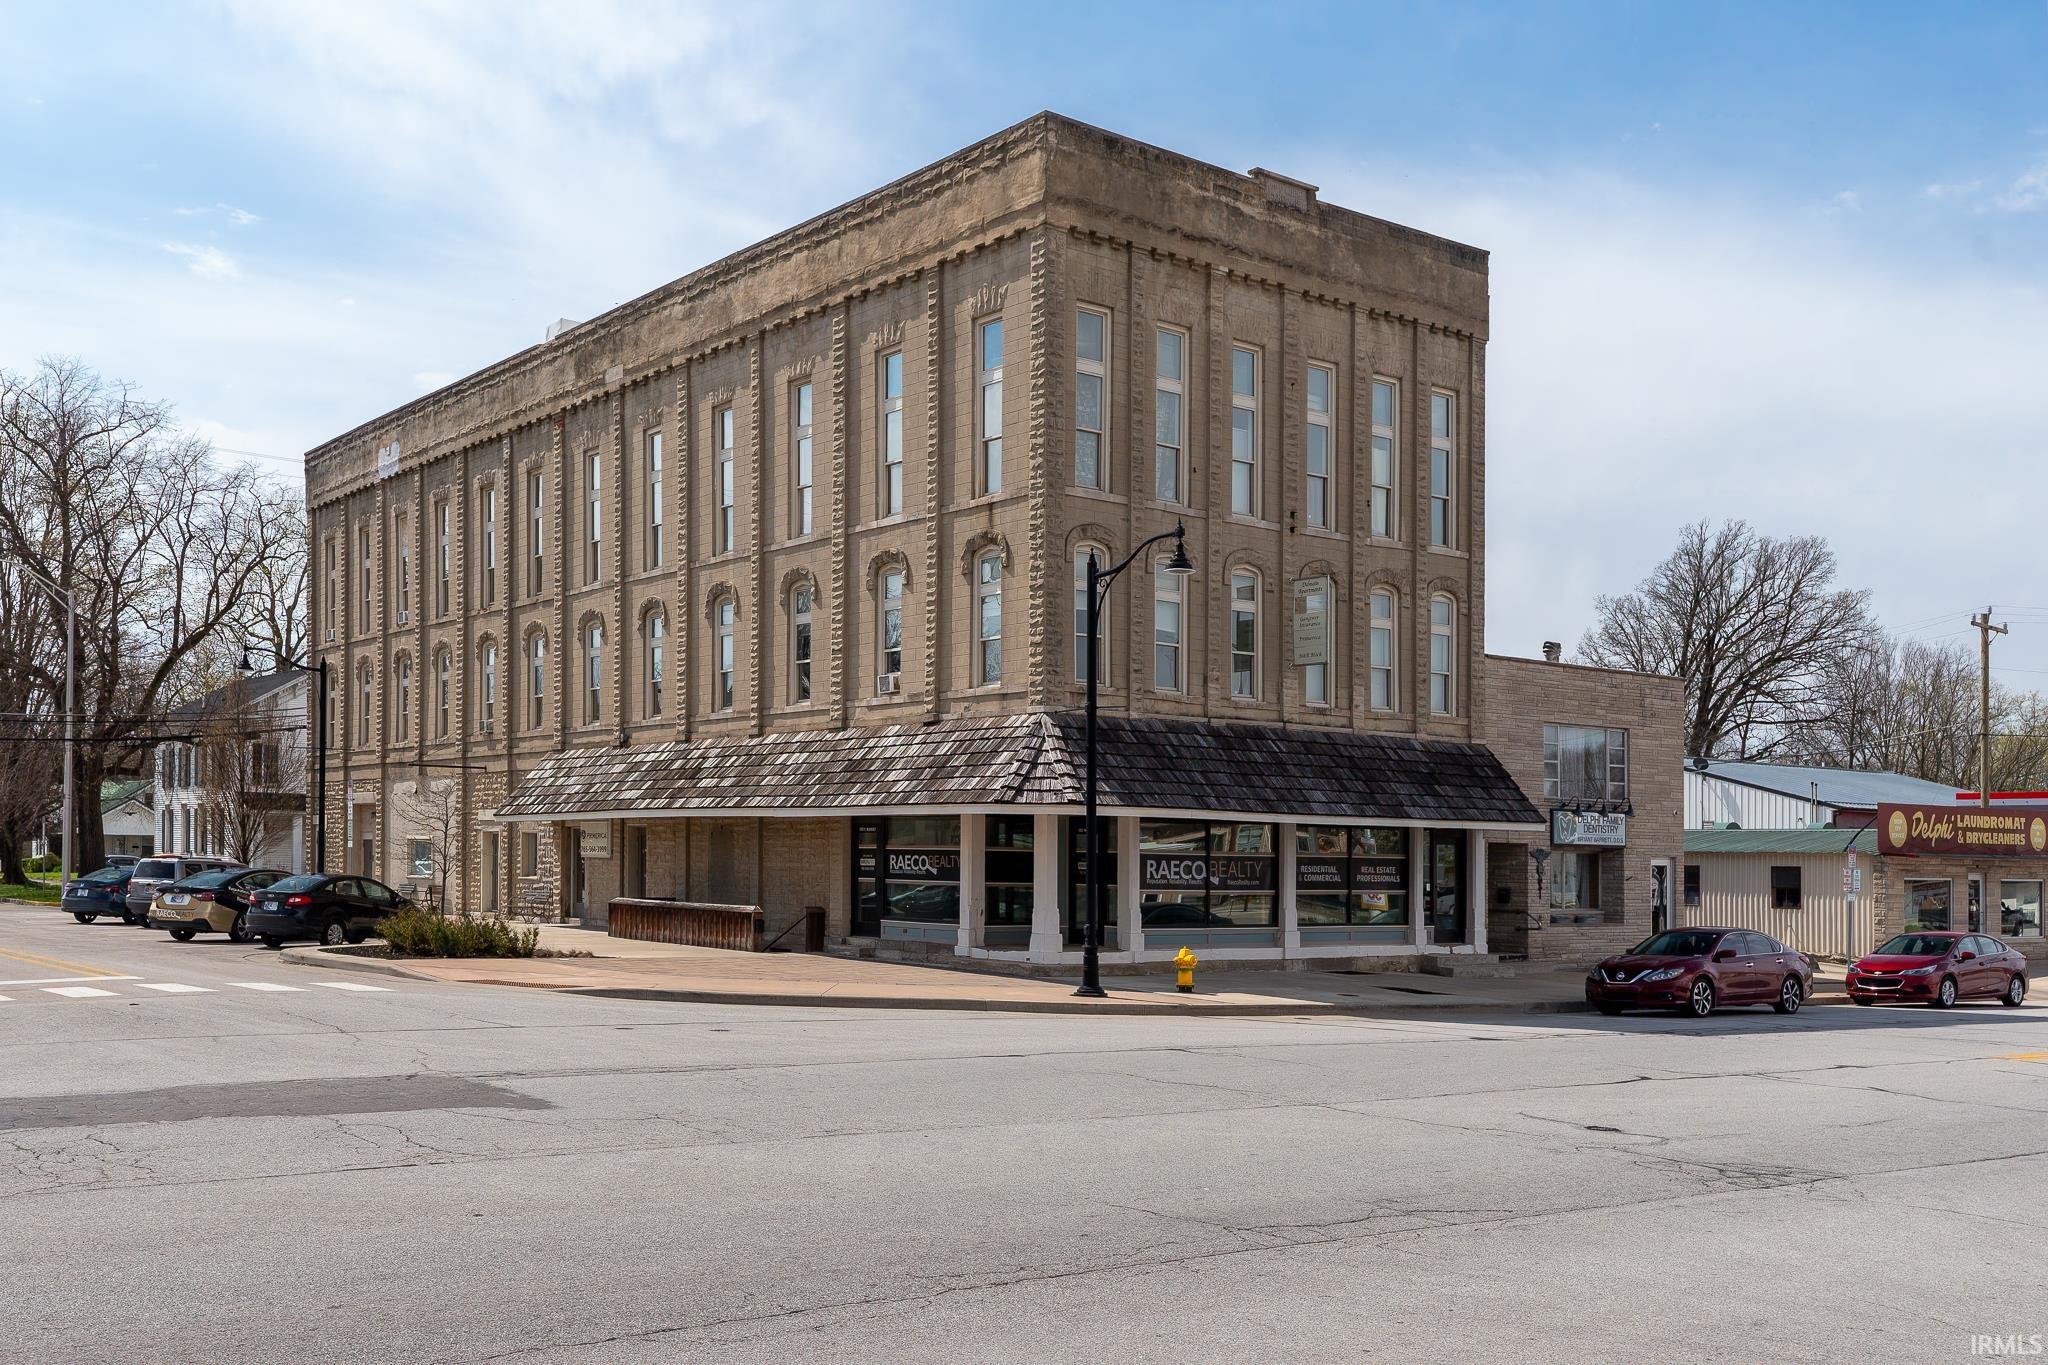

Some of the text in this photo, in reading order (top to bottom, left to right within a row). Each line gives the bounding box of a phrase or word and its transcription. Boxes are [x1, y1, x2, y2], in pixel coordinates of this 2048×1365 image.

[1578, 815, 1624, 825] DELPHI FAMILY
[1957, 815, 2026, 830] LAUNDROMAT
[1583, 824, 1619, 834] DENTISTRY
[1912, 811, 1954, 847] Delphi
[1957, 830, 1964, 844] &
[1966, 831, 2026, 845] DRYCLEANERS
[889, 854, 928, 871] RAECO
[1146, 859, 1206, 880] RAECO
[1300, 865, 1337, 873] RESIDENTIAL
[1361, 866, 1396, 874] REAL ESTATE
[1303, 874, 1342, 882] COMMERCIAL
[1356, 874, 1401, 882] PROFESSIONALS
